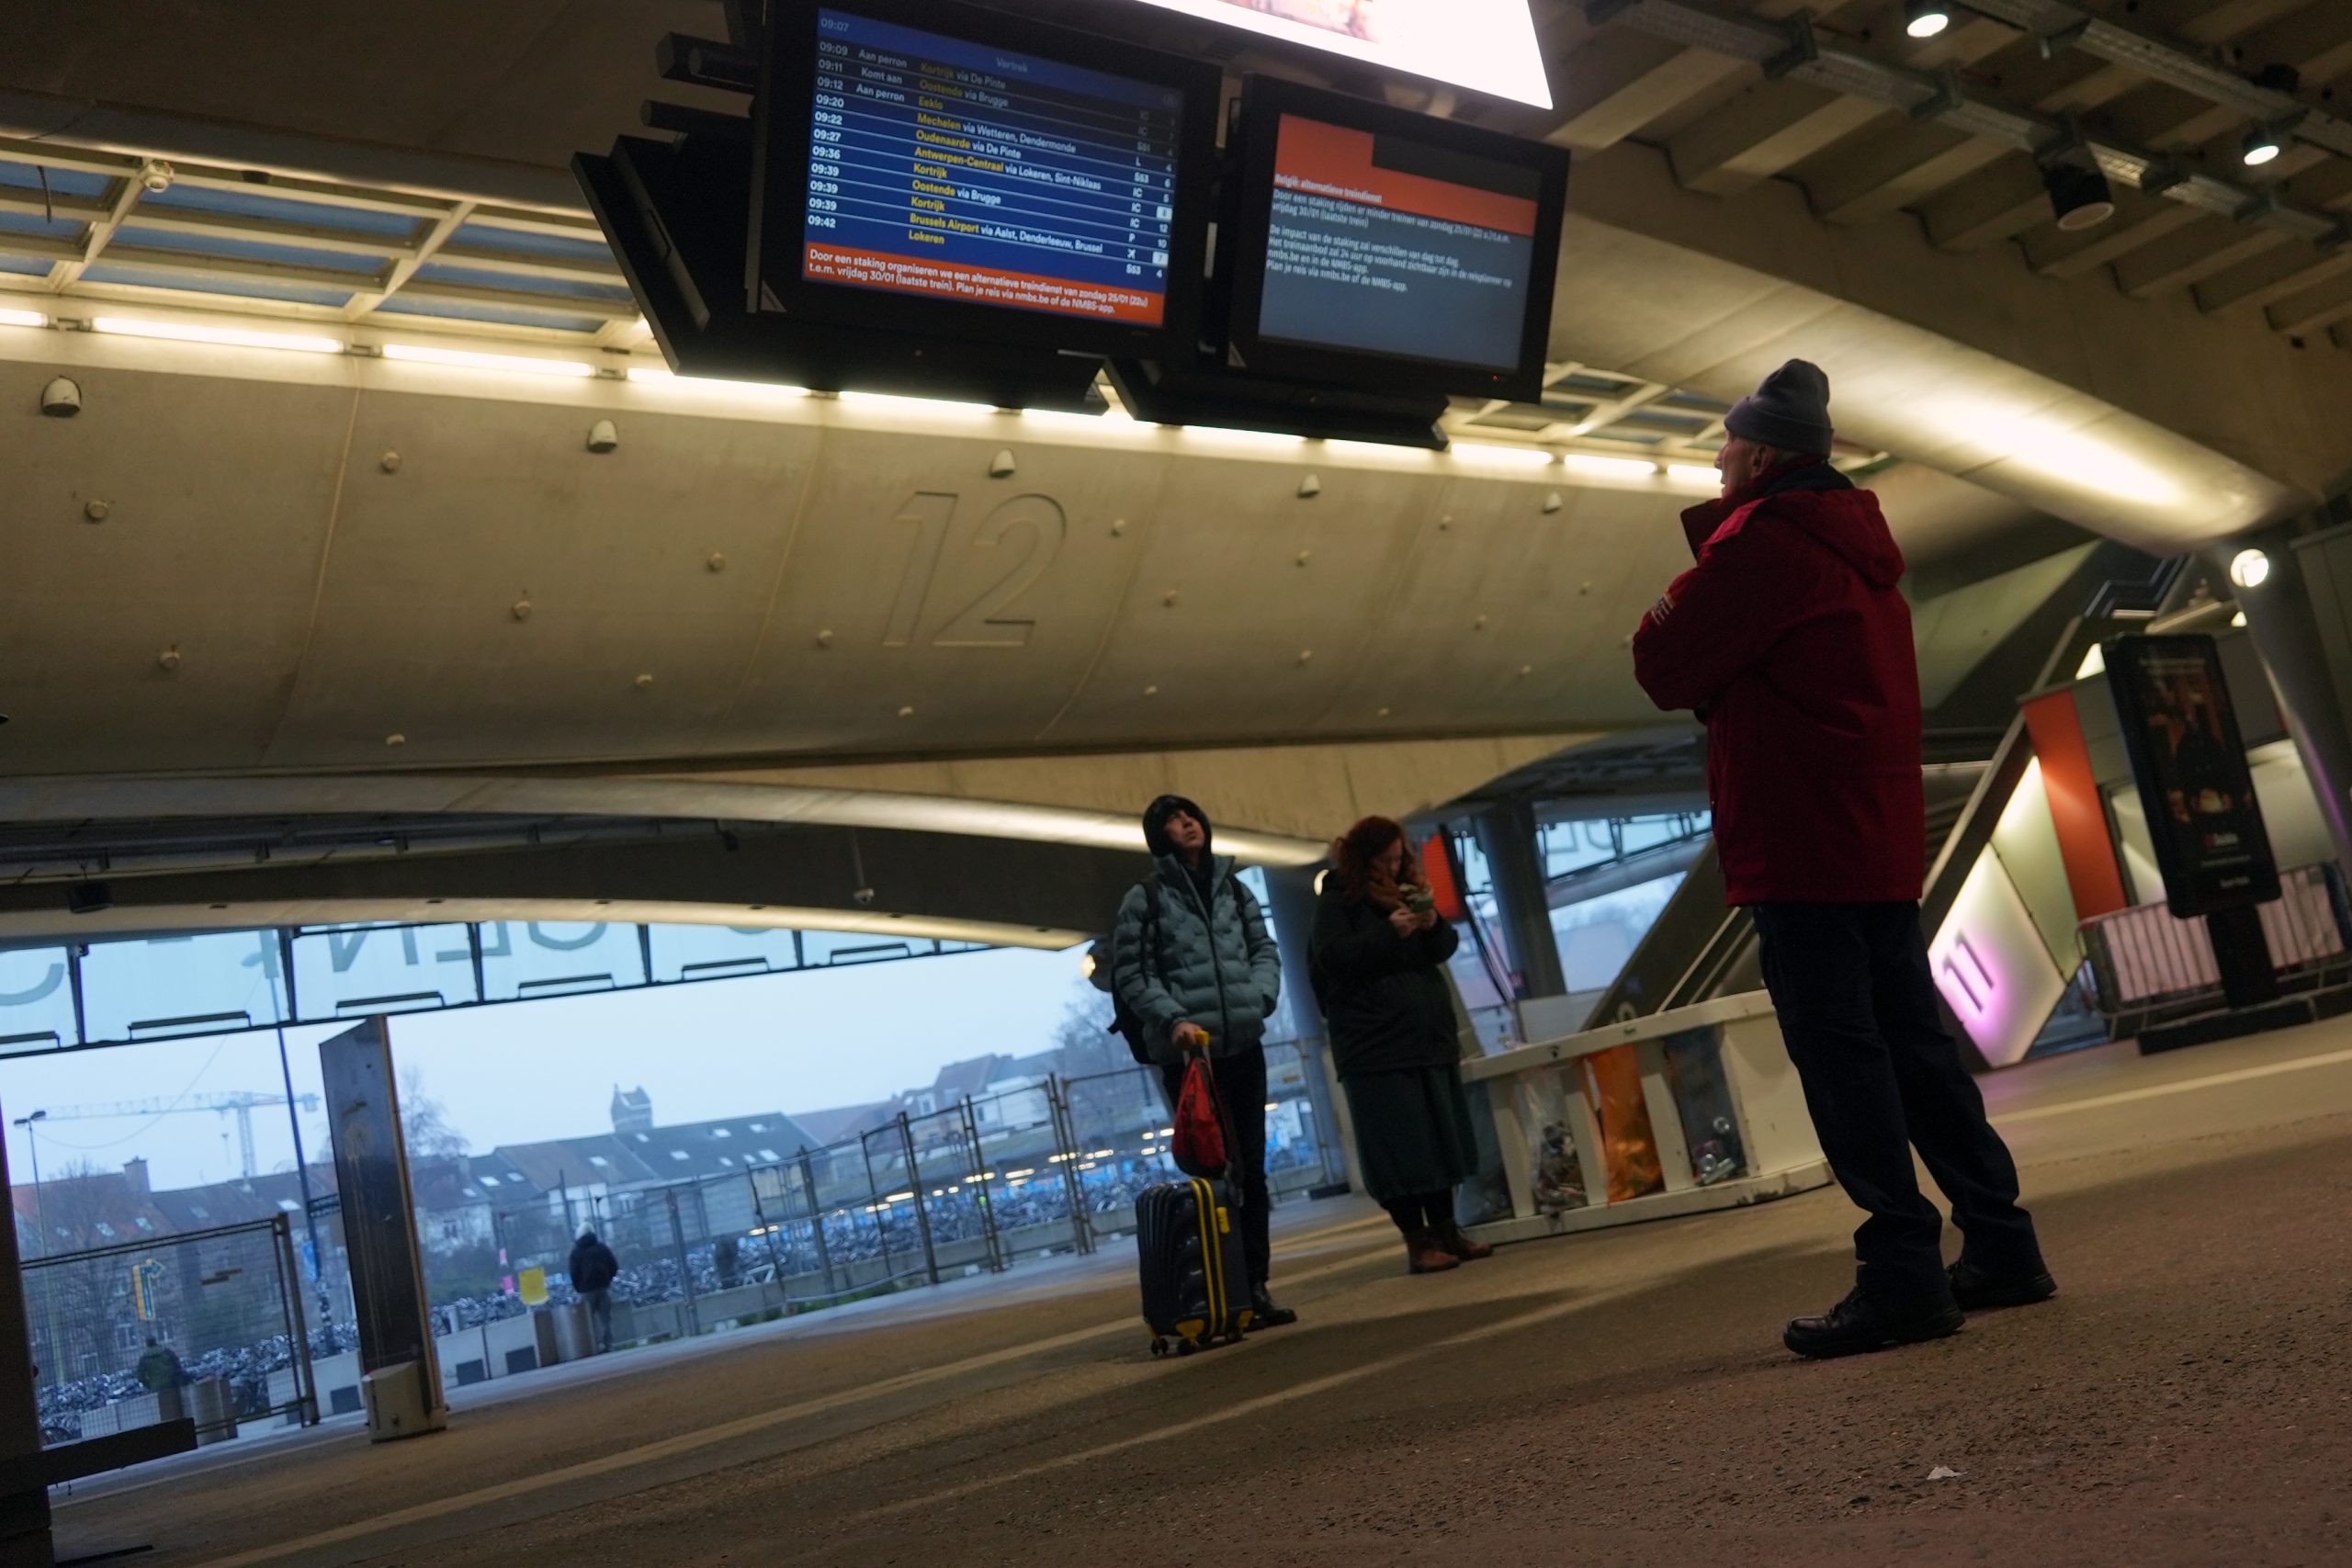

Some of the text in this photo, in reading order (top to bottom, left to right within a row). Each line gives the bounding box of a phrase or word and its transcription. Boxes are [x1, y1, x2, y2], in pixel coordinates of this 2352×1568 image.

[821, 17, 848, 32] 09:07
[819, 59, 842, 72] 09:11
[862, 67, 884, 79] Komt
[888, 74, 901, 83] aan
[920, 80, 962, 96] Oostende
[965, 89, 976, 99] via
[978, 92, 1008, 108] Brugge
[820, 41, 847, 55] 09:09
[859, 50, 876, 61] Aan
[878, 55, 906, 69] perron
[921, 62, 954, 79] Kortrijk
[956, 70, 968, 80] via
[971, 73, 981, 83] De
[985, 76, 1005, 88] Pinte
[997, 57, 1027, 73] Vertrek
[818, 76, 842, 89] 09:12
[857, 84, 875, 95] Aan
[876, 90, 904, 103] perron
[919, 96, 943, 109] Eeklo
[815, 111, 842, 125] 09:22
[916, 130, 970, 149] Oudenaarde
[972, 141, 984, 152] via
[986, 143, 998, 154] De
[1000, 146, 1021, 159] Pinte
[816, 94, 843, 107] 09:20
[918, 113, 960, 130] Mechelen
[963, 122, 974, 132] via
[977, 125, 1018, 142] Wetteren,
[1020, 133, 1076, 153] Dendermonde
[812, 146, 840, 159] 09:36
[913, 163, 946, 179] Kortrijk
[1131, 202, 1141, 213] IC
[814, 128, 841, 141] 09:27
[915, 146, 1003, 173] Antwerpen-Centraal
[1005, 164, 1017, 174] via
[1019, 165, 1053, 182] Lokeren,
[1055, 173, 1101, 190] Sint-Niklaas
[1133, 187, 1142, 197] IC
[810, 180, 837, 193] 09:39
[910, 197, 944, 211] Kortrijk
[1129, 233, 1135, 243] P
[811, 163, 839, 176] 09:39
[912, 180, 956, 196] Oostende
[957, 187, 968, 197] via
[971, 190, 1001, 206] Brugge
[1130, 218, 1139, 228] IC
[1272, 200, 1297, 215] vrijdag
[1273, 188, 1291, 200] Door
[1293, 194, 1307, 204] een
[1308, 195, 1335, 210] staking
[1367, 207, 1390, 220] minder
[808, 215, 1162, 277] 09:42 Lokeren S53 4
[809, 197, 836, 210] 09:39
[910, 213, 945, 228] Brussels
[948, 219, 978, 233] Airport
[980, 224, 992, 235] via
[994, 227, 1017, 240] Aalst,
[1019, 231, 1073, 249] Denderleeuw,
[1075, 240, 1102, 253] Brussel
[1270, 224, 1280, 233] De
[1281, 226, 1307, 240] impact
[1308, 232, 1321, 241] van
[1322, 233, 1332, 243] de
[1332, 235, 1359, 250] staking
[1360, 241, 1370, 250] zal
[1371, 243, 1408, 256] verschillen
[1420, 252, 1433, 264] dag
[810, 249, 832, 261] Door
[835, 254, 851, 264] een
[853, 255, 885, 271] staking
[887, 260, 937, 277] organiseren
[954, 272, 969, 280] een
[971, 272, 1018, 288] alternatieve
[1021, 279, 1062, 293] treindienst
[1064, 288, 1077, 296] van
[1079, 288, 1106, 301] zondag
[1108, 292, 1128, 303] 25/01
[1266, 260, 1283, 271] Plan
[1283, 264, 1292, 274] je
[1293, 265, 1306, 275] reis
[1307, 267, 1318, 276] via
[1319, 269, 1351, 282] nmbs.be
[1351, 274, 1359, 283] of
[1361, 276, 1370, 285] de
[1267, 248, 1299, 261] nmbs.be
[1311, 255, 1318, 265] in
[1320, 257, 1329, 266] de
[1329, 247, 1338, 256] zal
[1350, 252, 1363, 260] uur
[1363, 254, 1374, 264] op
[809, 263, 1114, 313] t.e.m. vrijdag 30/01 (laatste trein). Plan je reis via nmbs.be of de NMBS-app.
[881, 491, 1067, 647] 12
[1941, 929, 1995, 1014] 11
